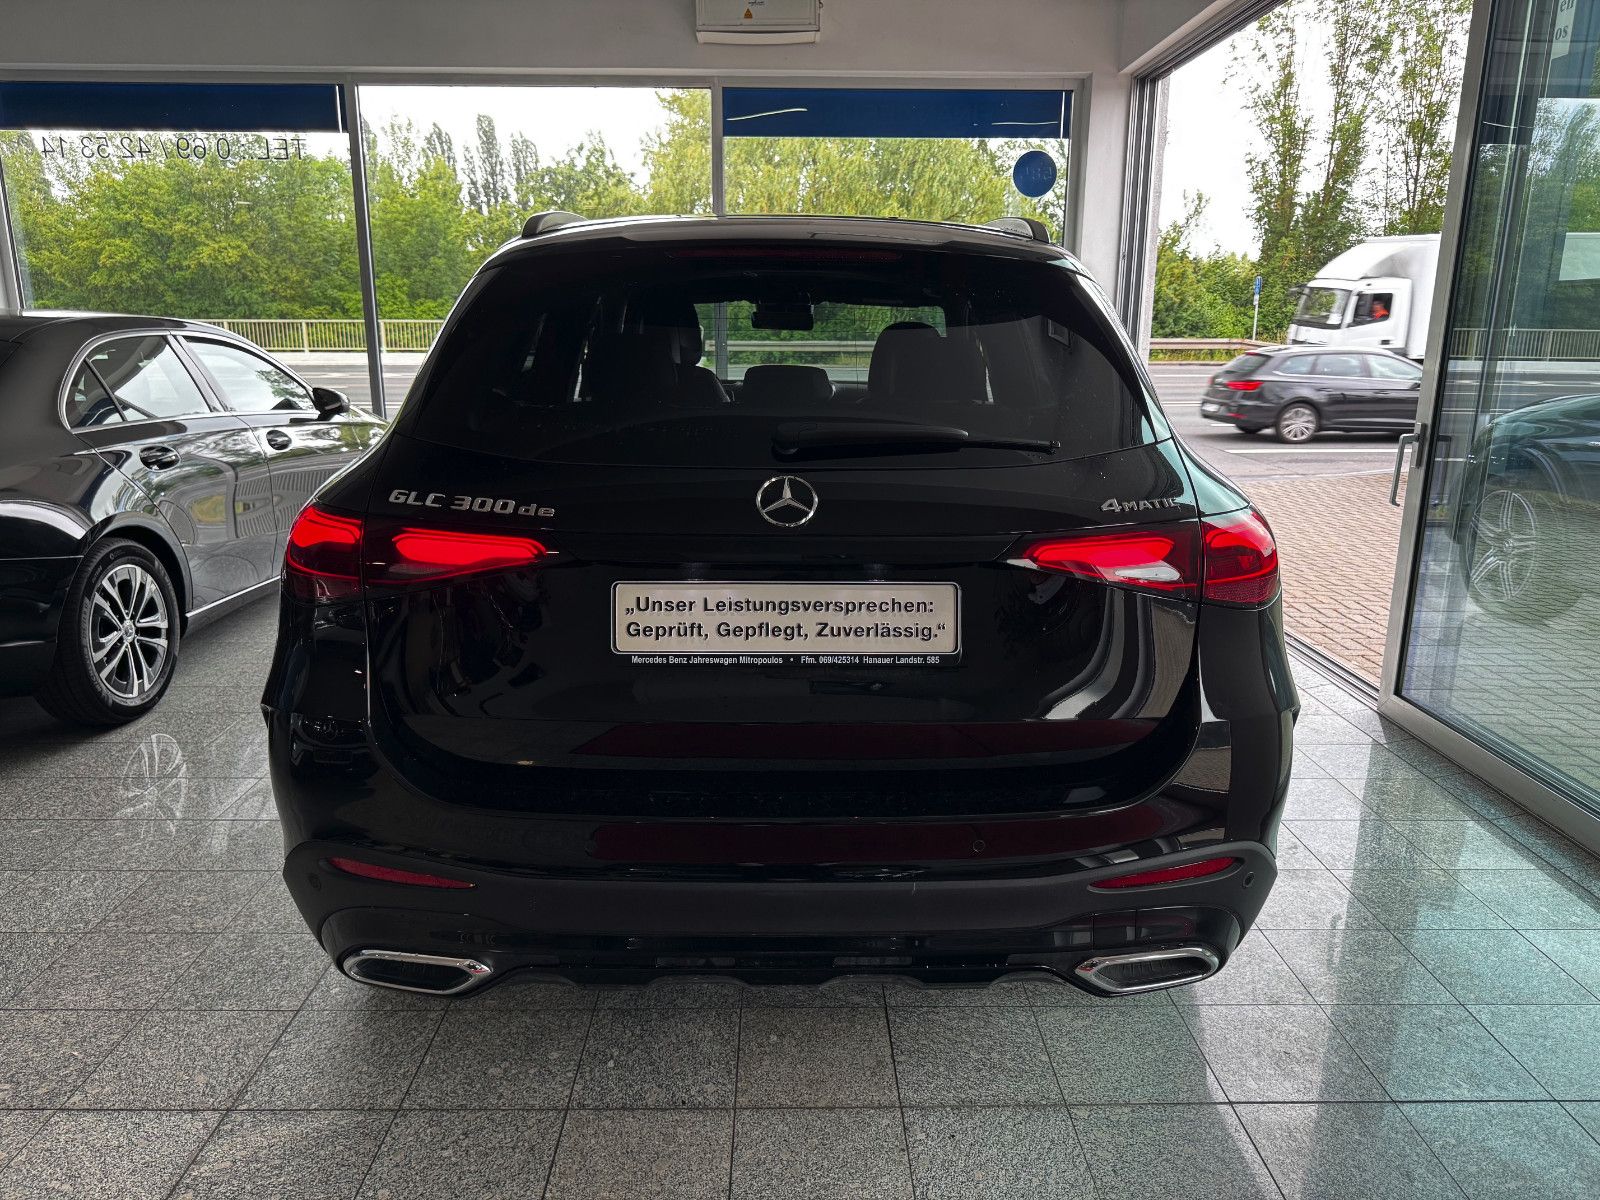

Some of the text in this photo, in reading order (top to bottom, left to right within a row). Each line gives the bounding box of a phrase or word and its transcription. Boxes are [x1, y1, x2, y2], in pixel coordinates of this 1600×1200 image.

[388, 489, 555, 517] GLC 300 de
[1100, 498, 1182, 513] 4MATIC
[703, 597, 934, 616] Leistungsversprechen:
[626, 621, 709, 641] Geprüft,
[717, 621, 809, 641] Gepflegt,
[631, 655, 940, 665] Mercedes Benz Jahreswagen Mitropoulos Ffm. 069/425314 Hanauer Landstr. 585
